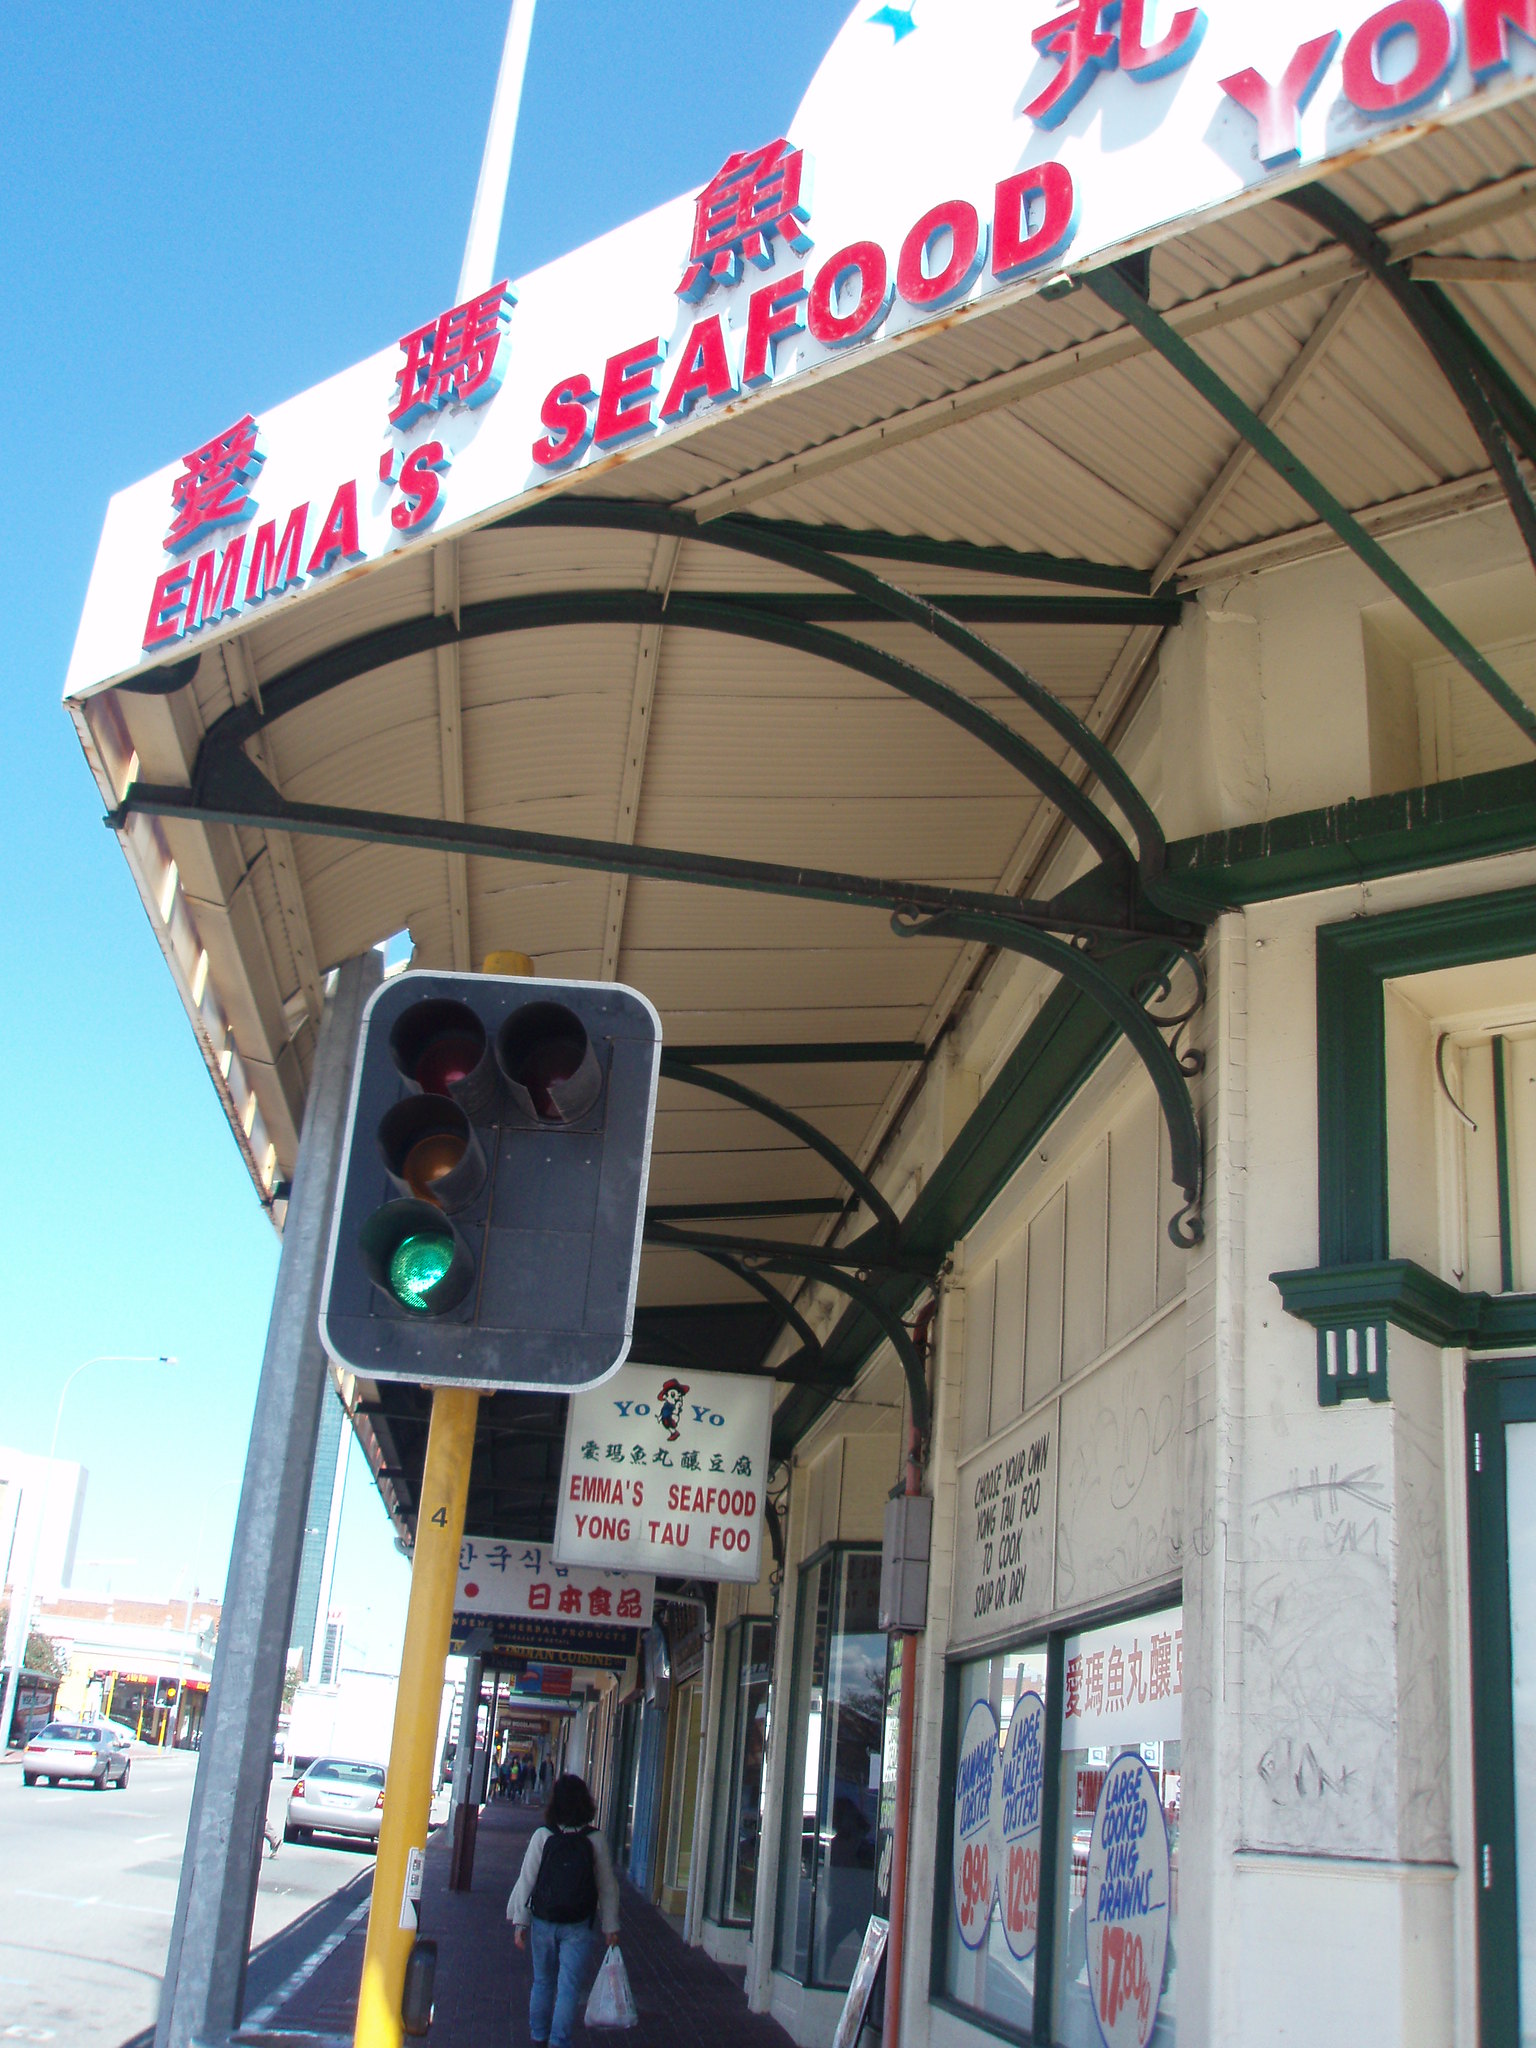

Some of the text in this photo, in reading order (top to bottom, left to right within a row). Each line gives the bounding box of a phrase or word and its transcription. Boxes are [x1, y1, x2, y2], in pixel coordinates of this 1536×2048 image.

[142, 440, 451, 652] EMMA'S
[532, 161, 1078, 470] SEAFOOD
[974, 1431, 1050, 1510] CHOOSE YOUR OWN
[431, 1506, 448, 1528] 4
[569, 1474, 757, 1518] EMMA'S SEAFOOD
[976, 1477, 1041, 1543] YONG TAU FOO
[574, 1514, 751, 1553] YONG TAU FOO
[982, 1527, 1024, 1577] TO COOK
[527, 1582, 643, 1619] 日本食品
[974, 1563, 1027, 1619] SOUP OR DRY
[558, 1650, 614, 1667] CUISINE
[561, 1627, 628, 1643] PRODUCTS
[1011, 1708, 1041, 1759] LARGE
[957, 1730, 999, 1801] CHAMPAGNE
[1001, 1753, 1021, 1799] HALF
[1105, 1766, 1144, 1810] LARGE
[959, 1772, 993, 1836] LOBSTER
[1002, 1778, 1043, 1836] OYSTERS
[1101, 1798, 1148, 1850] COOKED
[1105, 1841, 1140, 1883] KING
[1096, 1868, 1153, 1922] PRAWNS
